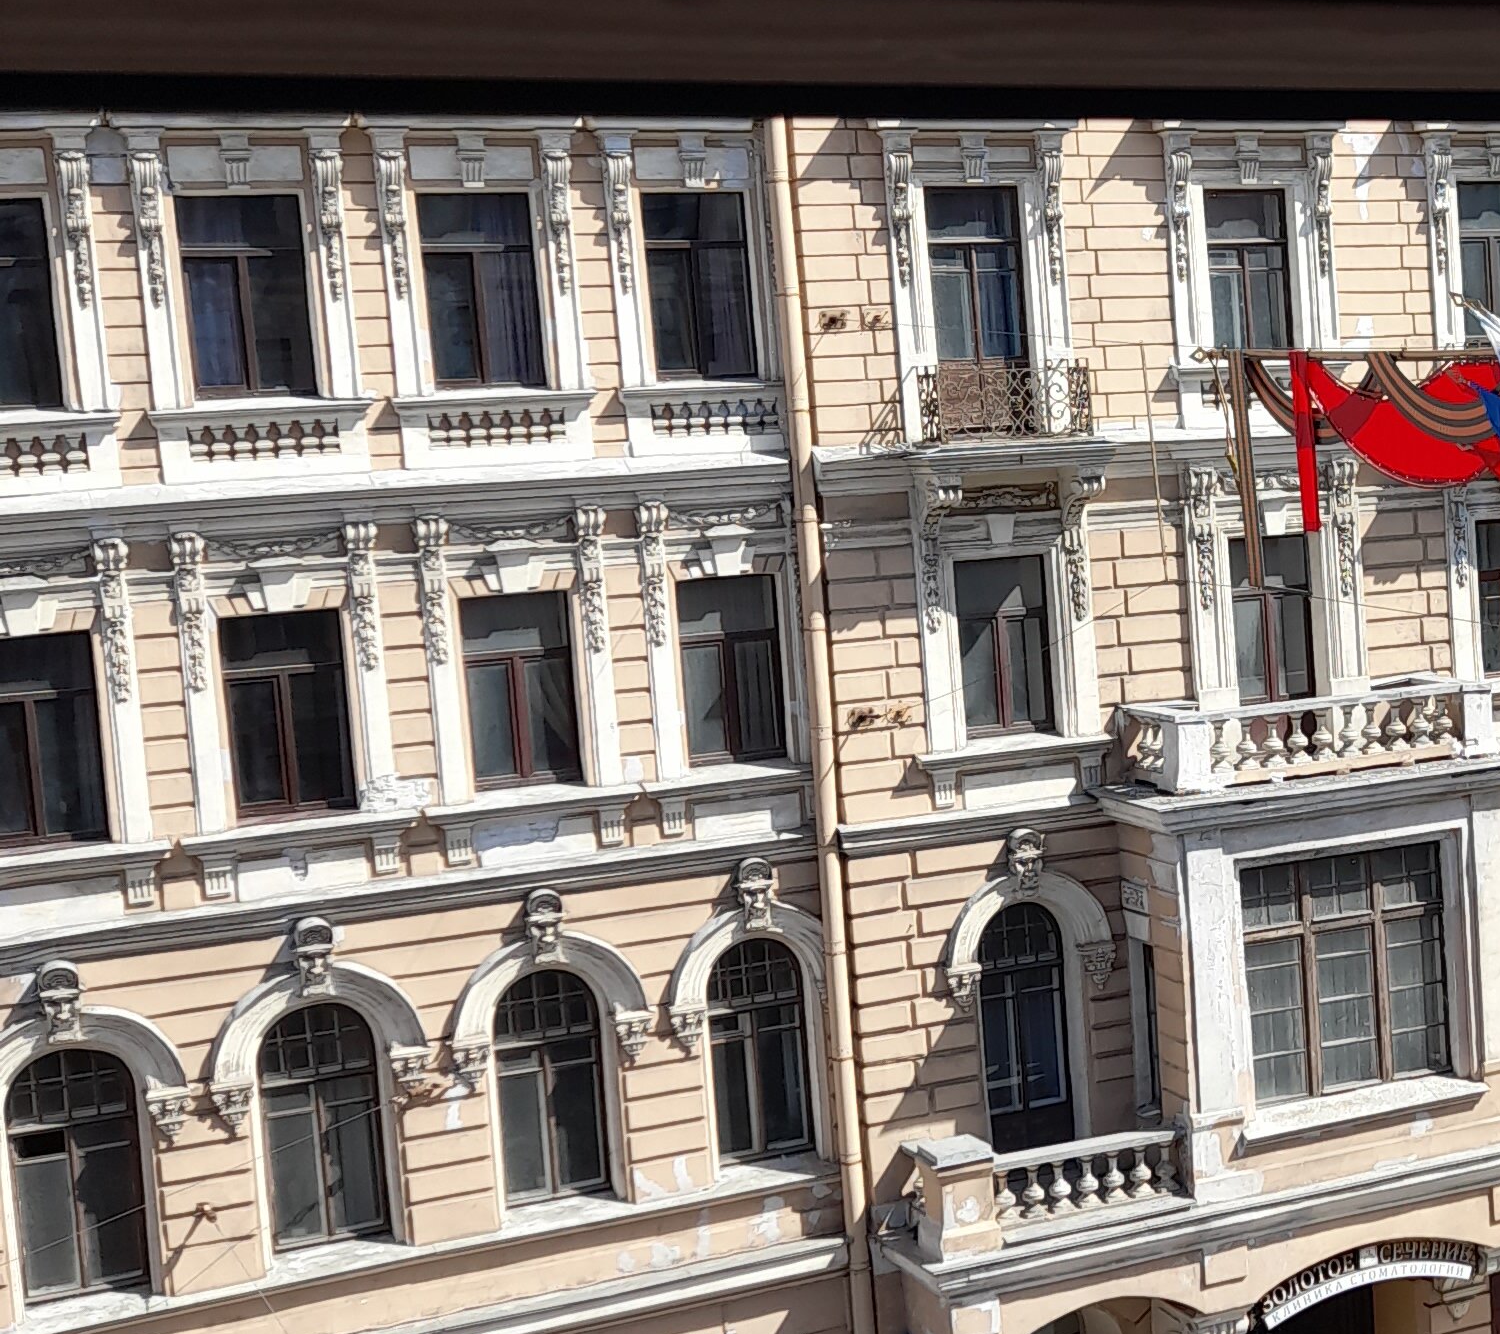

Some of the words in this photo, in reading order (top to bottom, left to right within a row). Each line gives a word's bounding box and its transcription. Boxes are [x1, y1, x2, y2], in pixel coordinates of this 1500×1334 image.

[1261, 1253, 1355, 1313] ЗОЛОТОЕ
[1272, 1281, 1344, 1323] КЛИНИКА
[1350, 1263, 1465, 1286] СТОМАТОЛОГИИ
